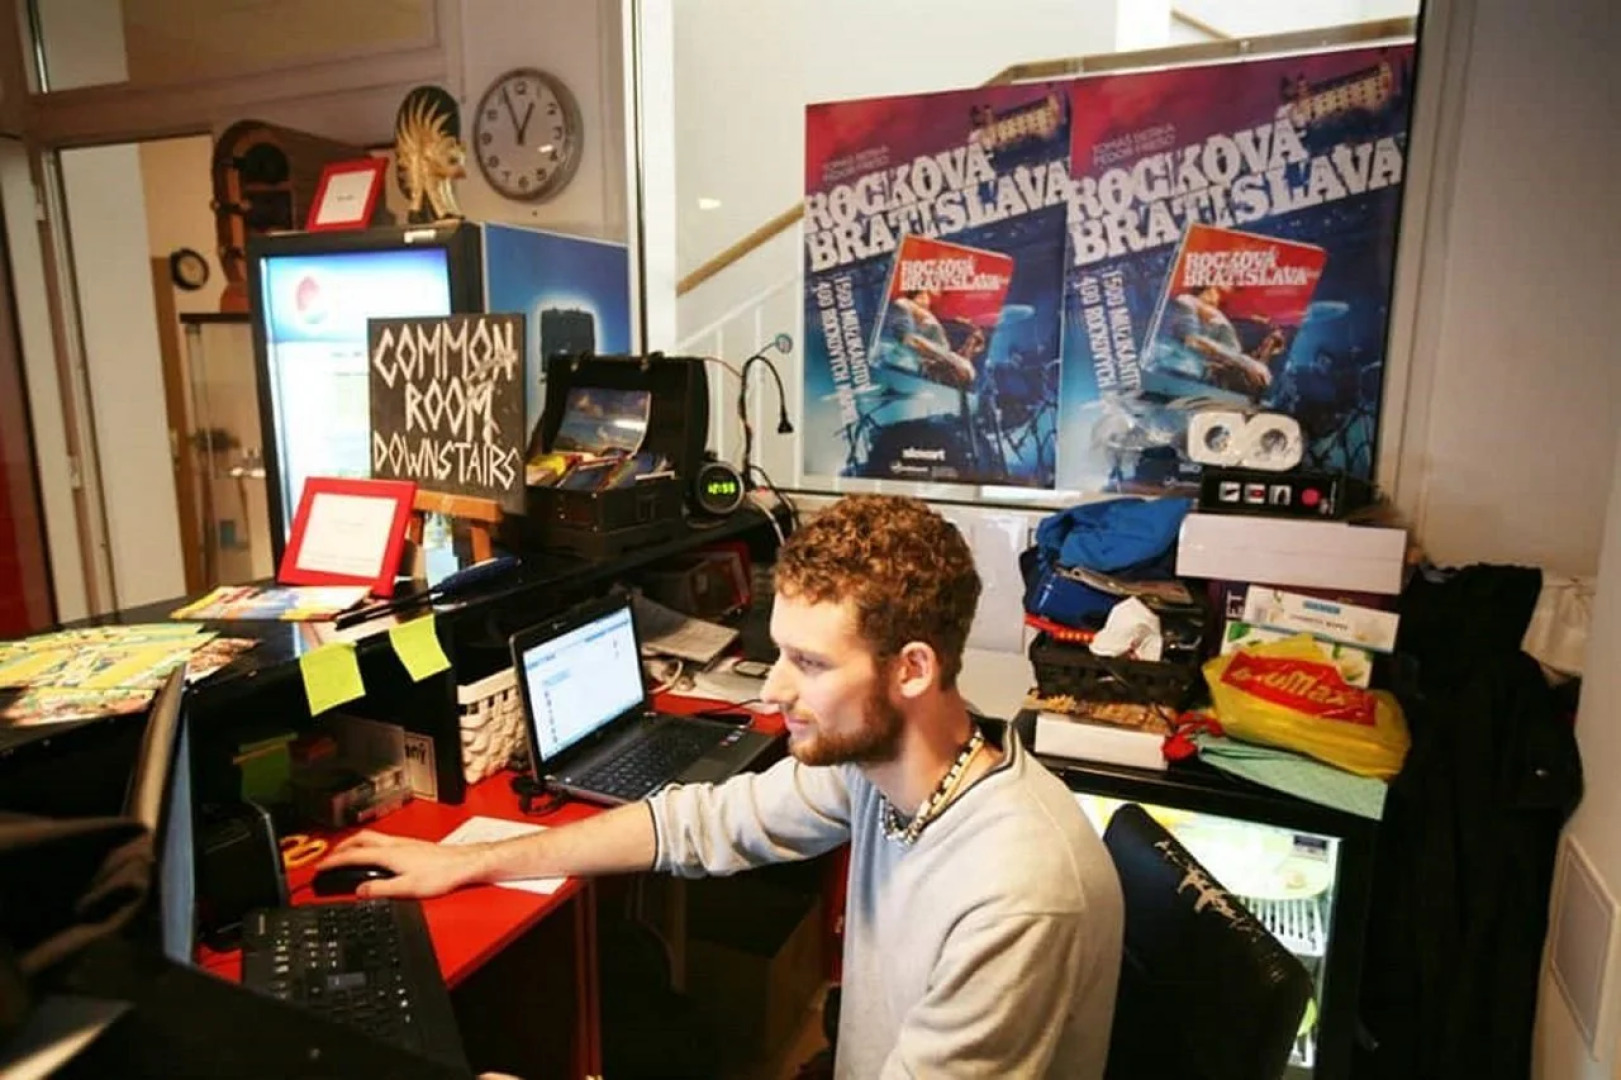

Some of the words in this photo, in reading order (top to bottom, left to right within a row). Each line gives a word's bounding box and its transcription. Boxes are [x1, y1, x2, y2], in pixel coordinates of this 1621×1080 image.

[805, 160, 1071, 272] BRATISLAVA
[1070, 137, 1403, 267] BRATISLAVA
[373, 318, 517, 389] COMMON
[404, 376, 494, 446] ROOM
[373, 430, 522, 490] DOWNSTAIRS
